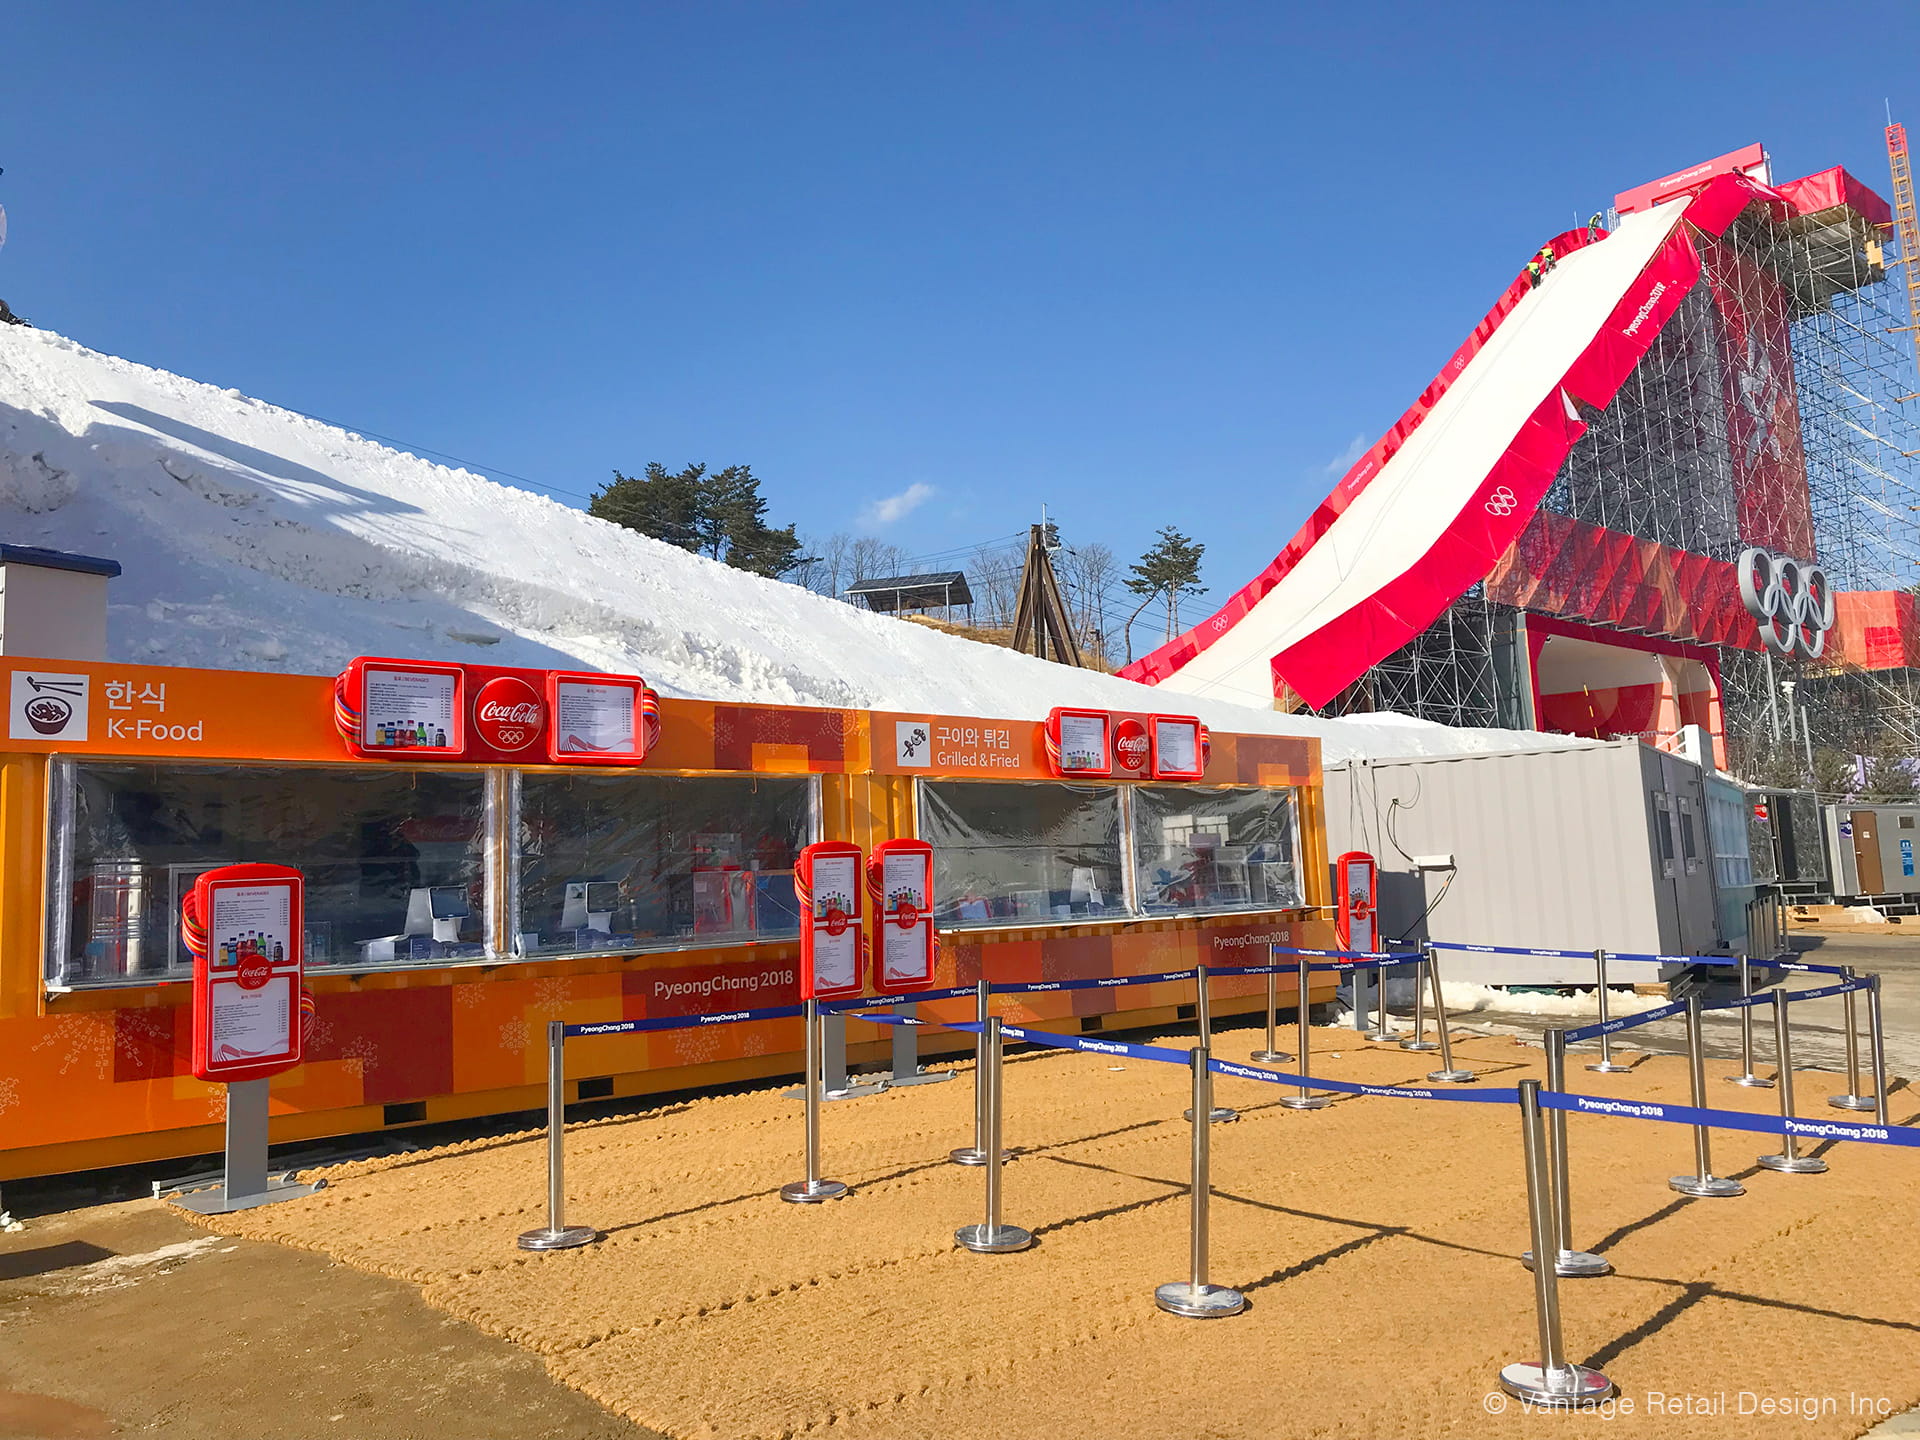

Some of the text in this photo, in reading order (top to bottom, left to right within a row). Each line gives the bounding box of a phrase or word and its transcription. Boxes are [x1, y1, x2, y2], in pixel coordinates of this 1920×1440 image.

[104, 680, 166, 712] 한식
[480, 700, 541, 724] Coca-Cola
[108, 718, 202, 742] K-Food
[936, 727, 1010, 749] 구이와 튀김
[937, 751, 1020, 768] Grilled & Fried
[1213, 930, 1290, 951] PyeongChang 2018
[654, 969, 794, 1001] PyeongChang 2018
[700, 1011, 750, 1025] PyeongChang 2018
[580, 1022, 635, 1035] PyeongChang 2018
[1219, 1062, 1279, 1081] PyeongChang 2018
[1361, 1086, 1433, 1098] PyeongChang 2018
[1578, 1097, 1664, 1117] PyeongChang 2018
[1785, 1120, 1889, 1140] PyeongChang 2018
